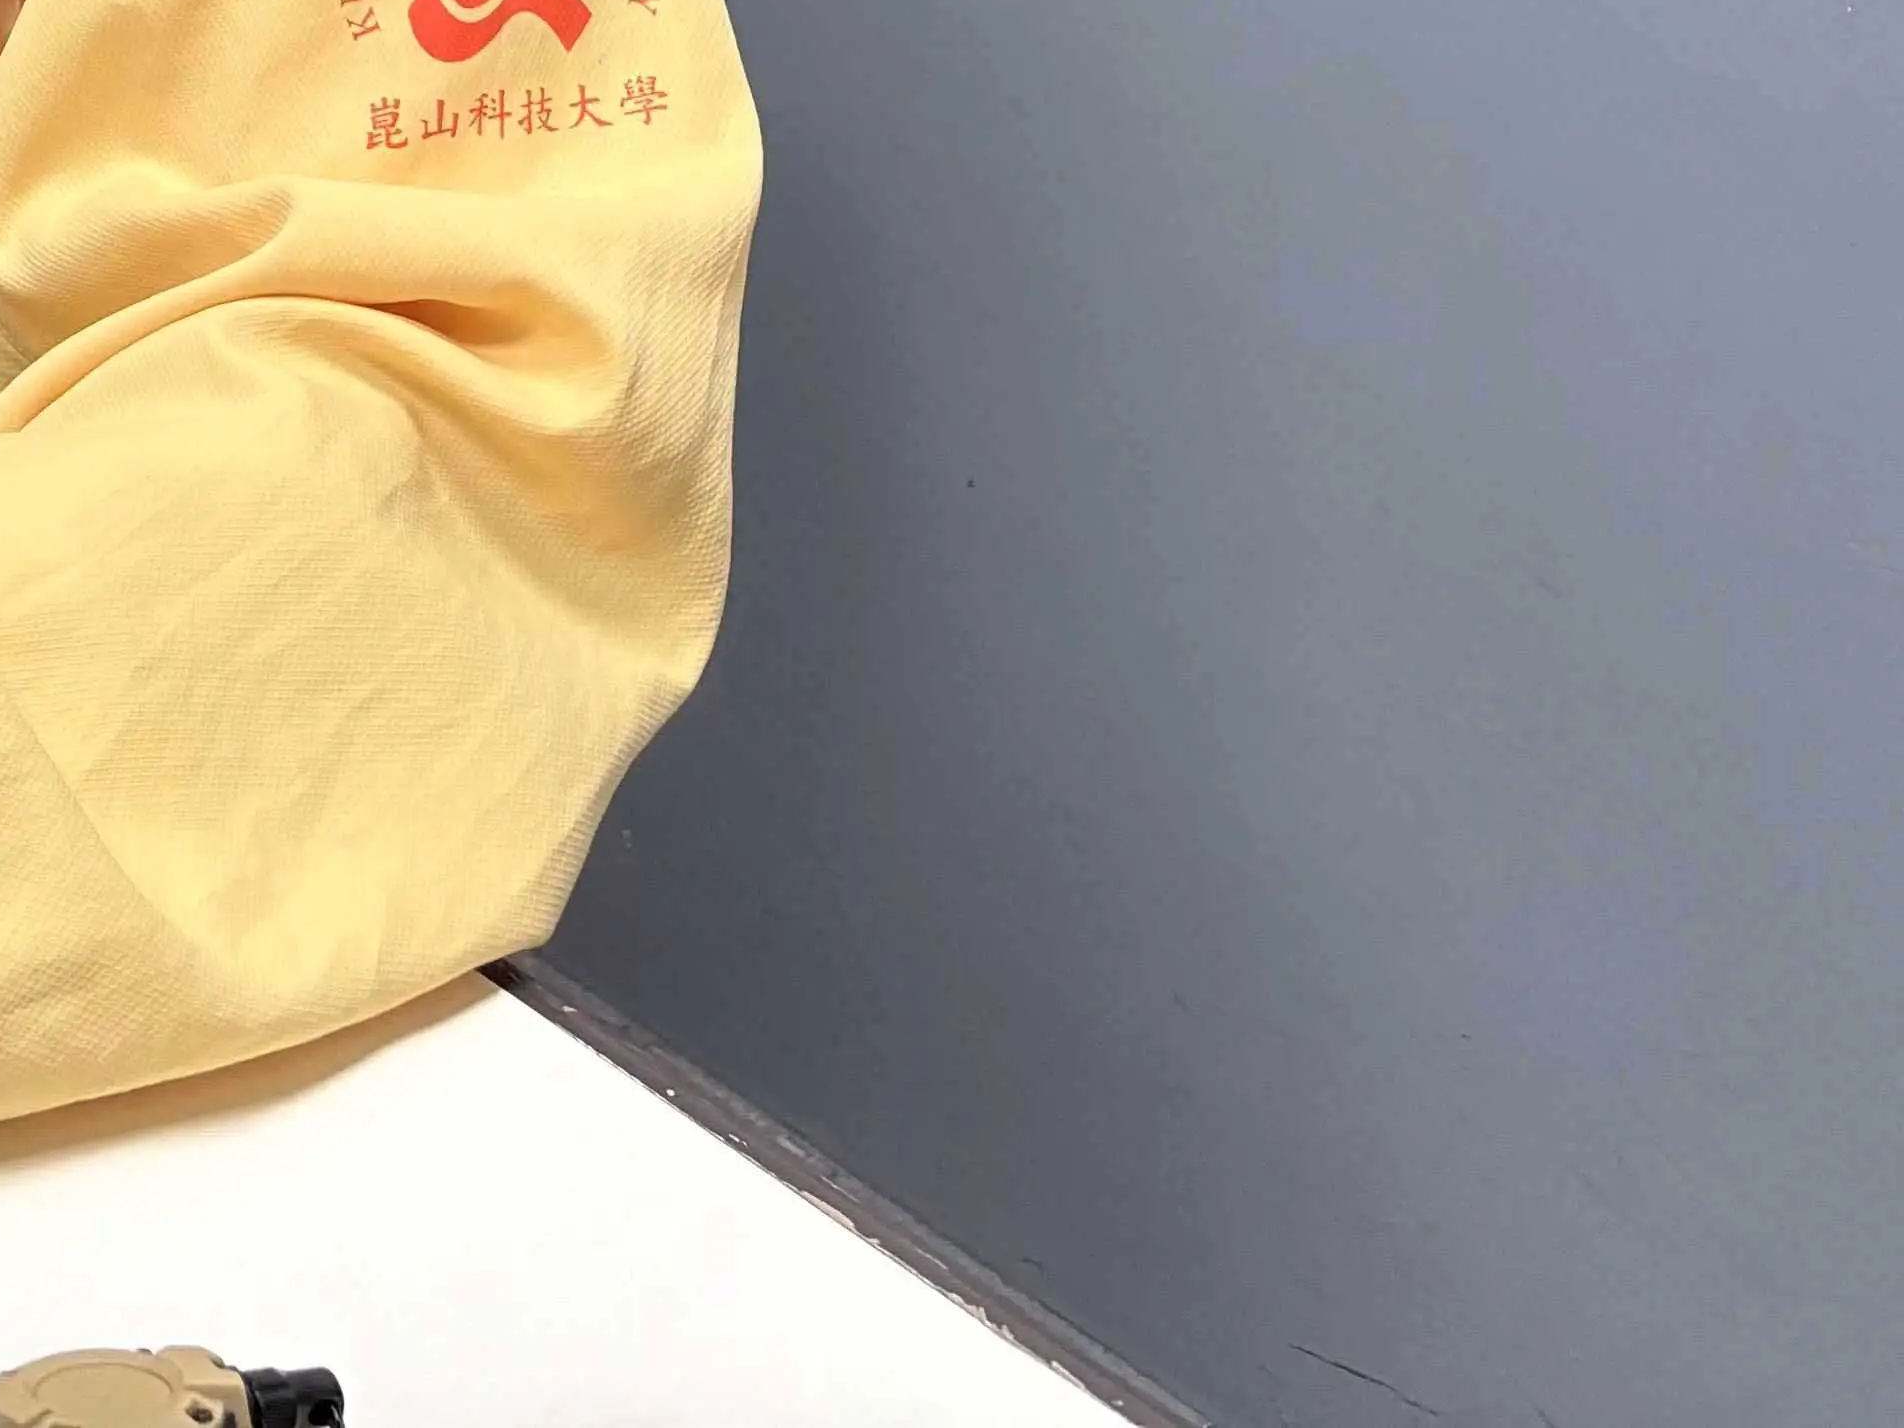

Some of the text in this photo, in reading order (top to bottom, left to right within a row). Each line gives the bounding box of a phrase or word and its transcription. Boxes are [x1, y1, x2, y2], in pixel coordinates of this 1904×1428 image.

[365, 74, 669, 151] 崑山科技大學
